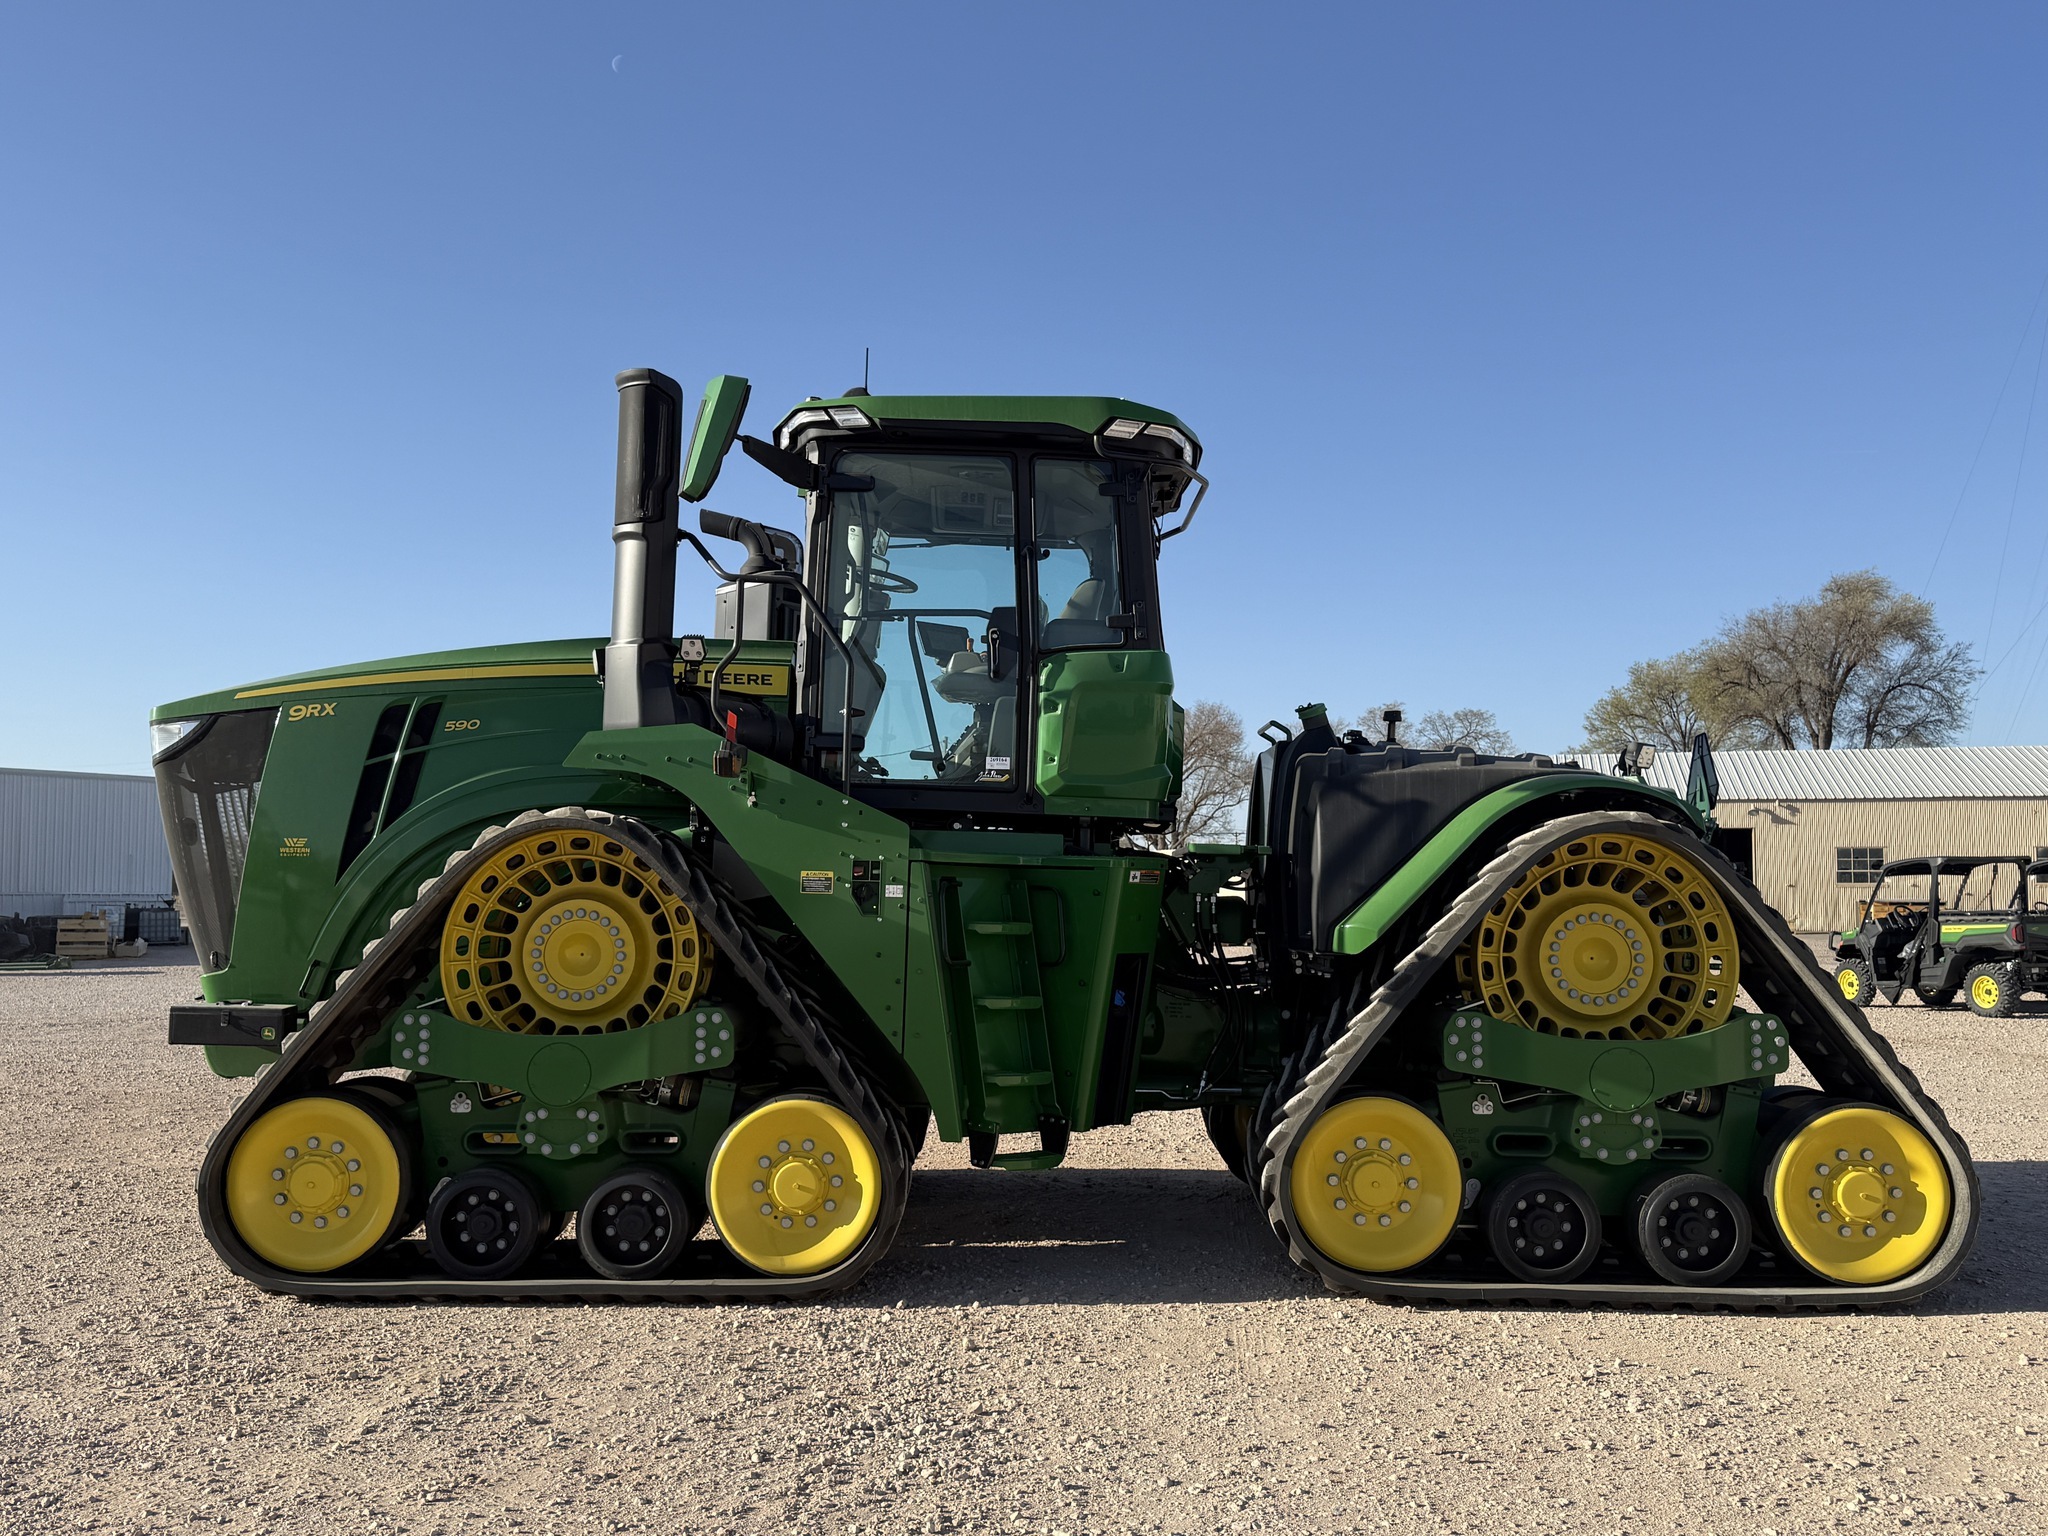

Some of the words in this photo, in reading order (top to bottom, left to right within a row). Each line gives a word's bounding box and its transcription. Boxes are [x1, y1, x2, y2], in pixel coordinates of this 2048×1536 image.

[704, 670, 773, 686] DEERE
[288, 702, 338, 722] 9RX
[444, 719, 481, 731] 590
